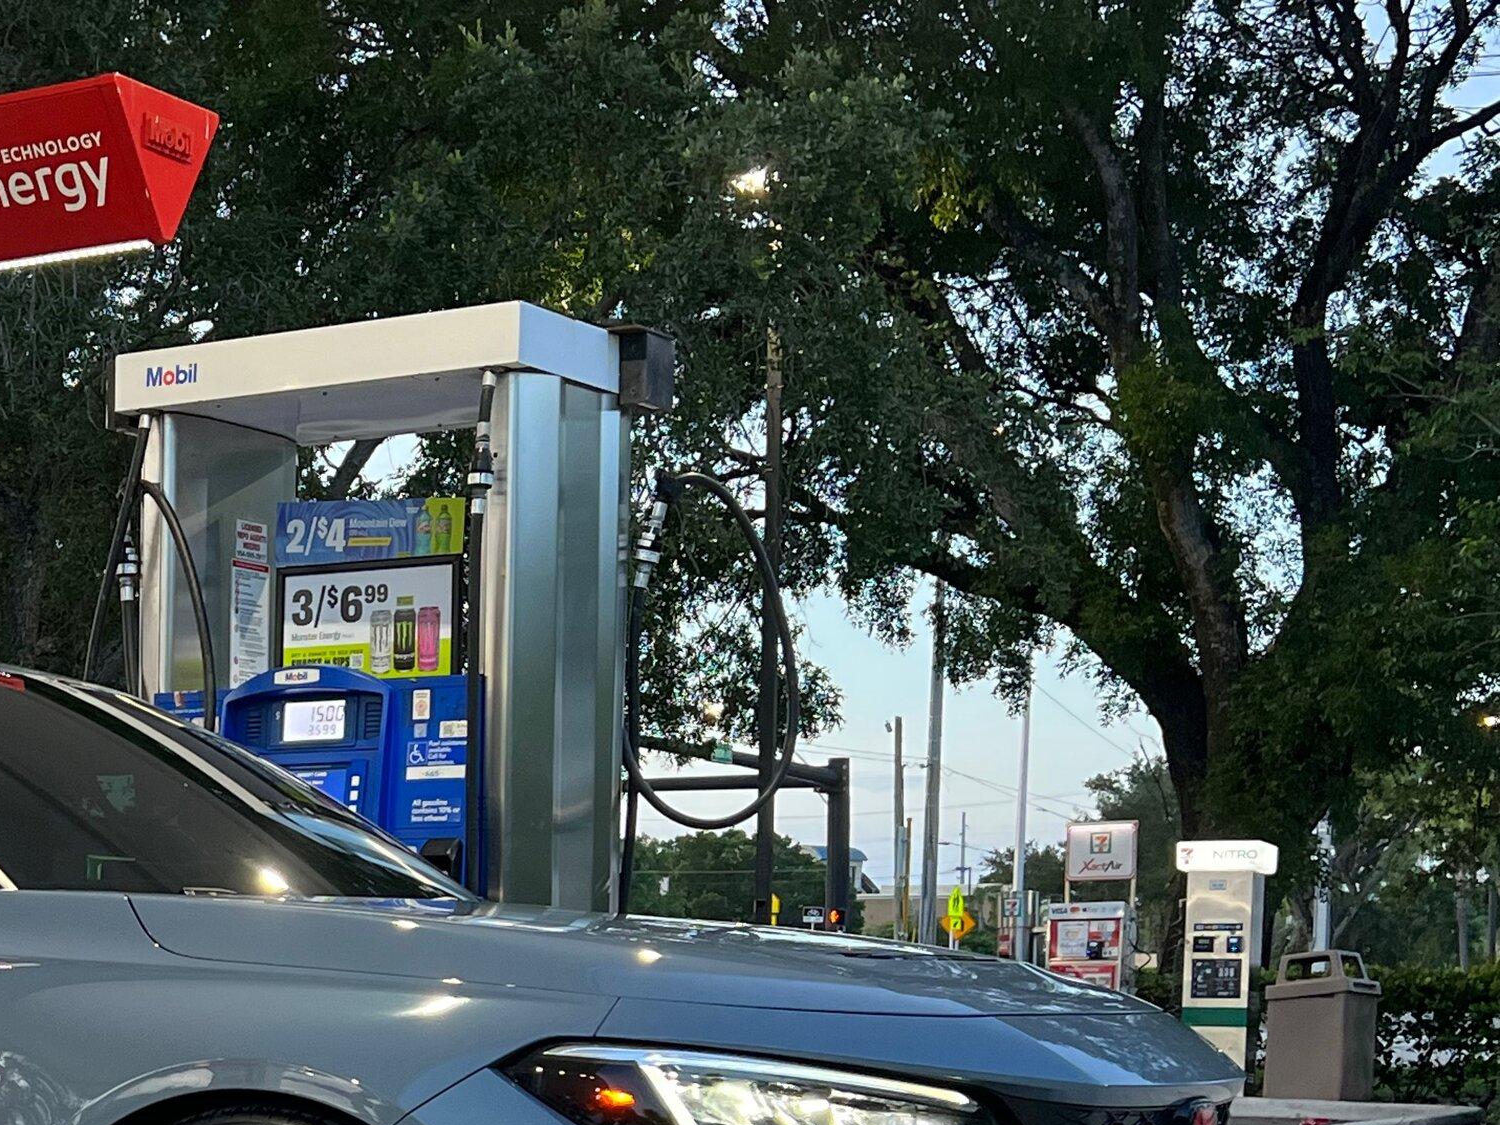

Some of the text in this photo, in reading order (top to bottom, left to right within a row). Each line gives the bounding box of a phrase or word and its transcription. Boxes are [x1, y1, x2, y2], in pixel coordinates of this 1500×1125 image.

[146, 363, 198, 388] Mobil
[285, 671, 308, 681] Mobil
[1213, 849, 1258, 860] NITRO
